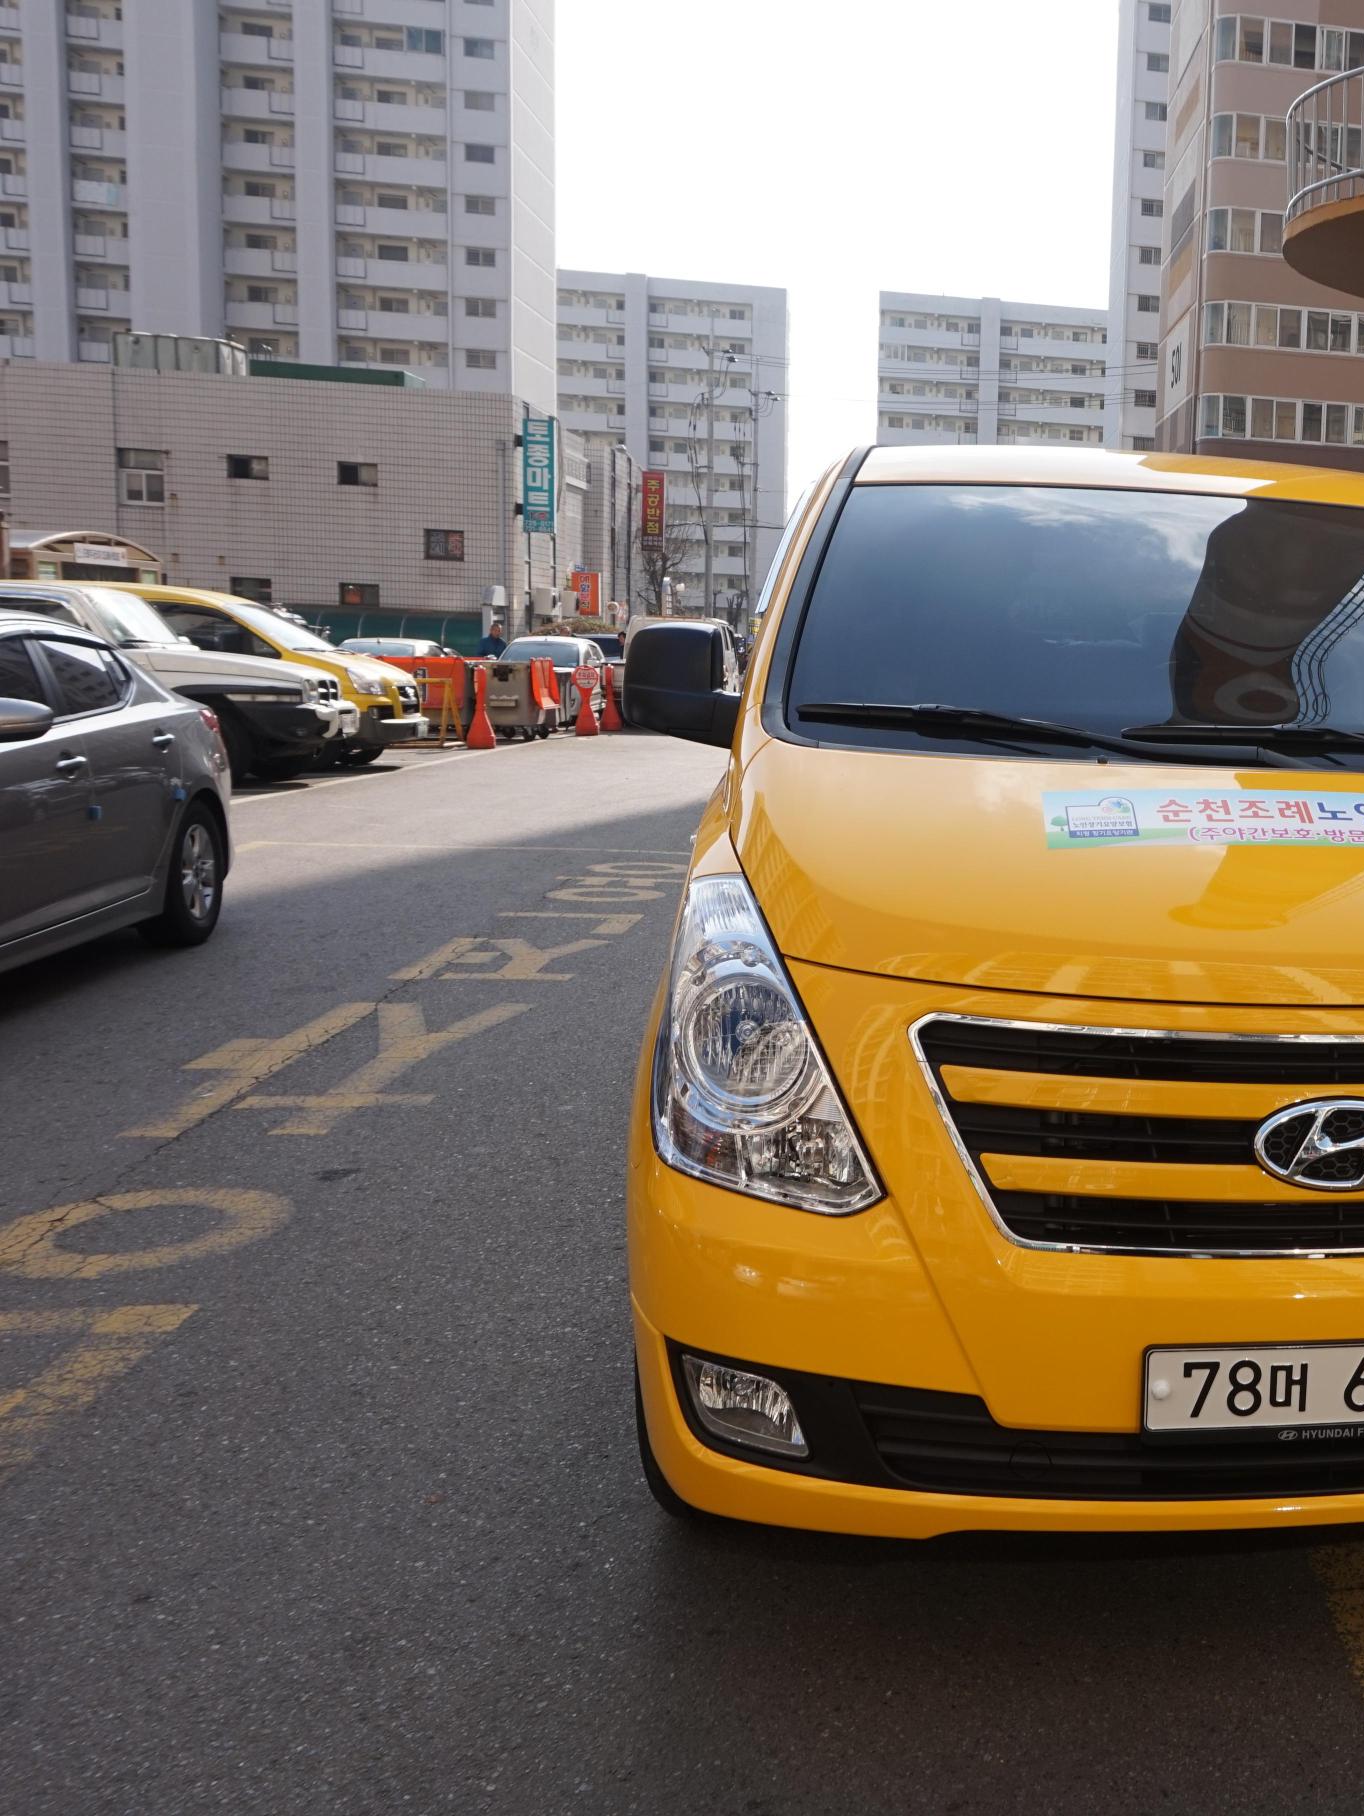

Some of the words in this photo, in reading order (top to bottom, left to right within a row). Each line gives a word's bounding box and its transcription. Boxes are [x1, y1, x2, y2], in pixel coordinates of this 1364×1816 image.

[526, 421, 552, 511] 토종마트
[647, 479, 661, 535] 주공반점
[1183, 1359, 1308, 1418] 78머
[1302, 1428, 1354, 1439] HYUNDAI
